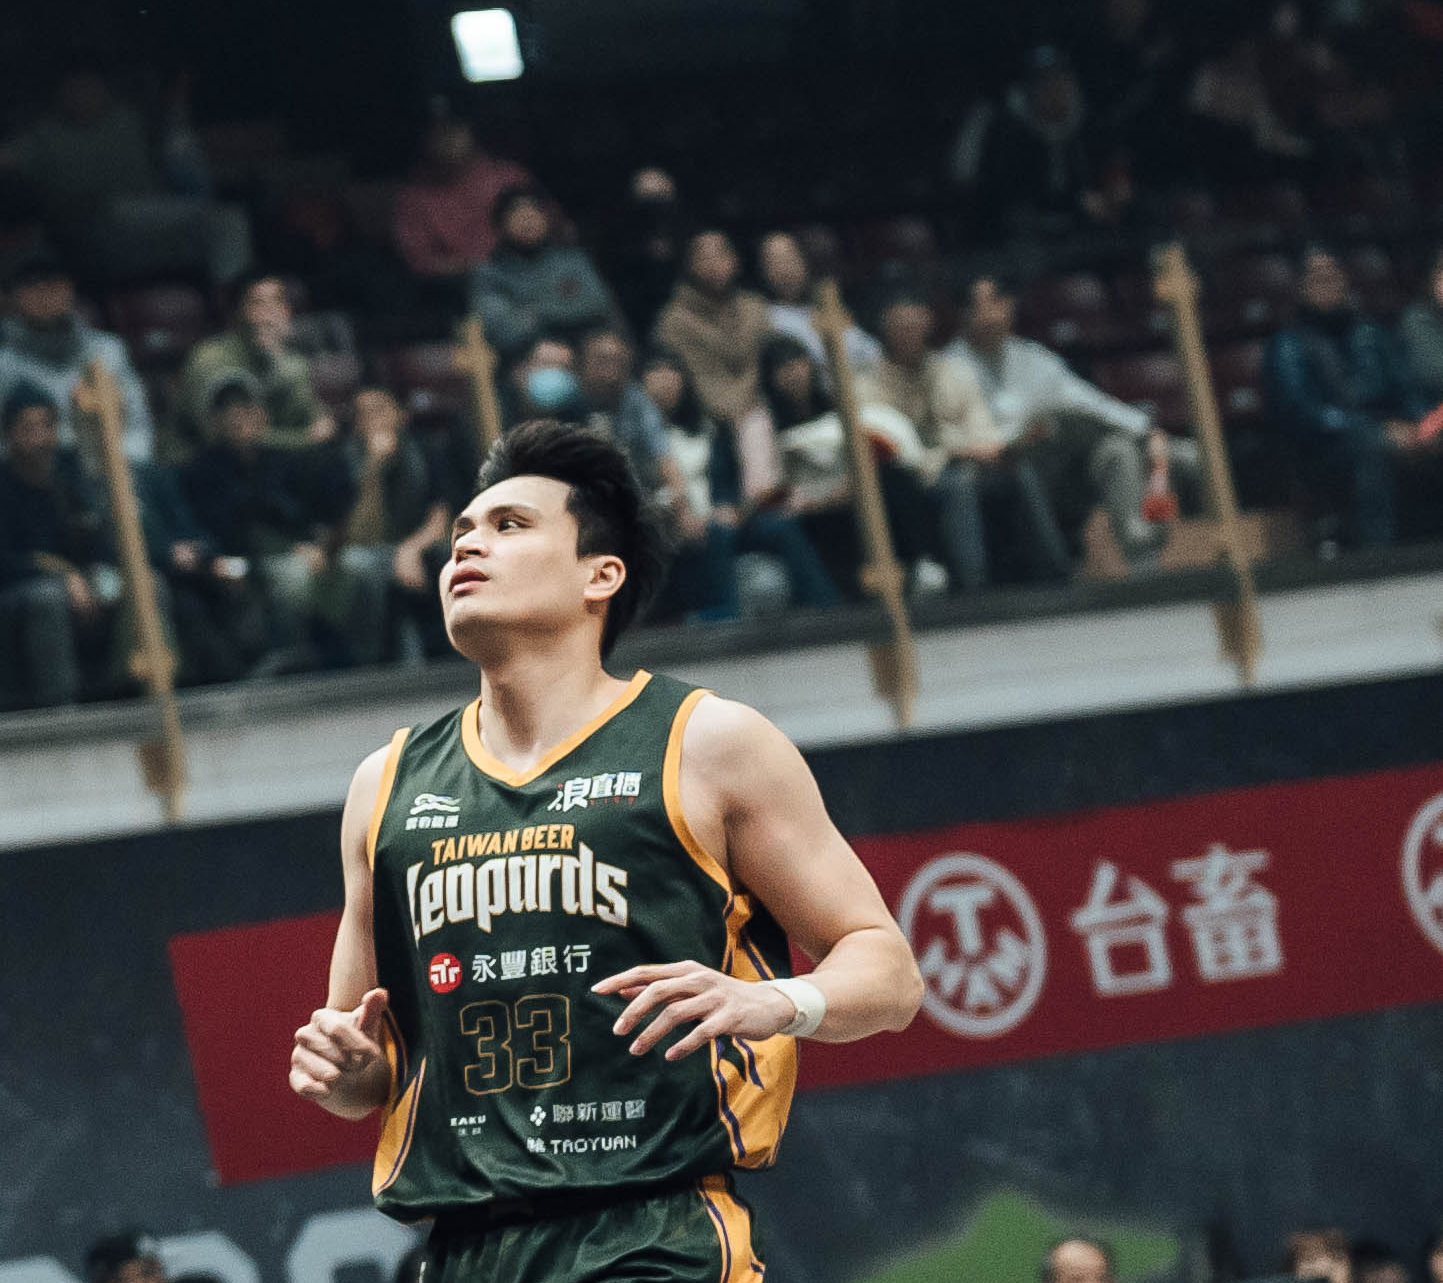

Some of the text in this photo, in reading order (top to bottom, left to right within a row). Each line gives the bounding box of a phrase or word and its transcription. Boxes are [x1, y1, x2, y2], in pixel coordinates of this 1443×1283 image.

[431, 823, 576, 866] TAIWAN BEER
[1071, 842, 1288, 999] 台畜
[472, 944, 592, 984] 永豐銀行
[458, 992, 571, 1097] 33
